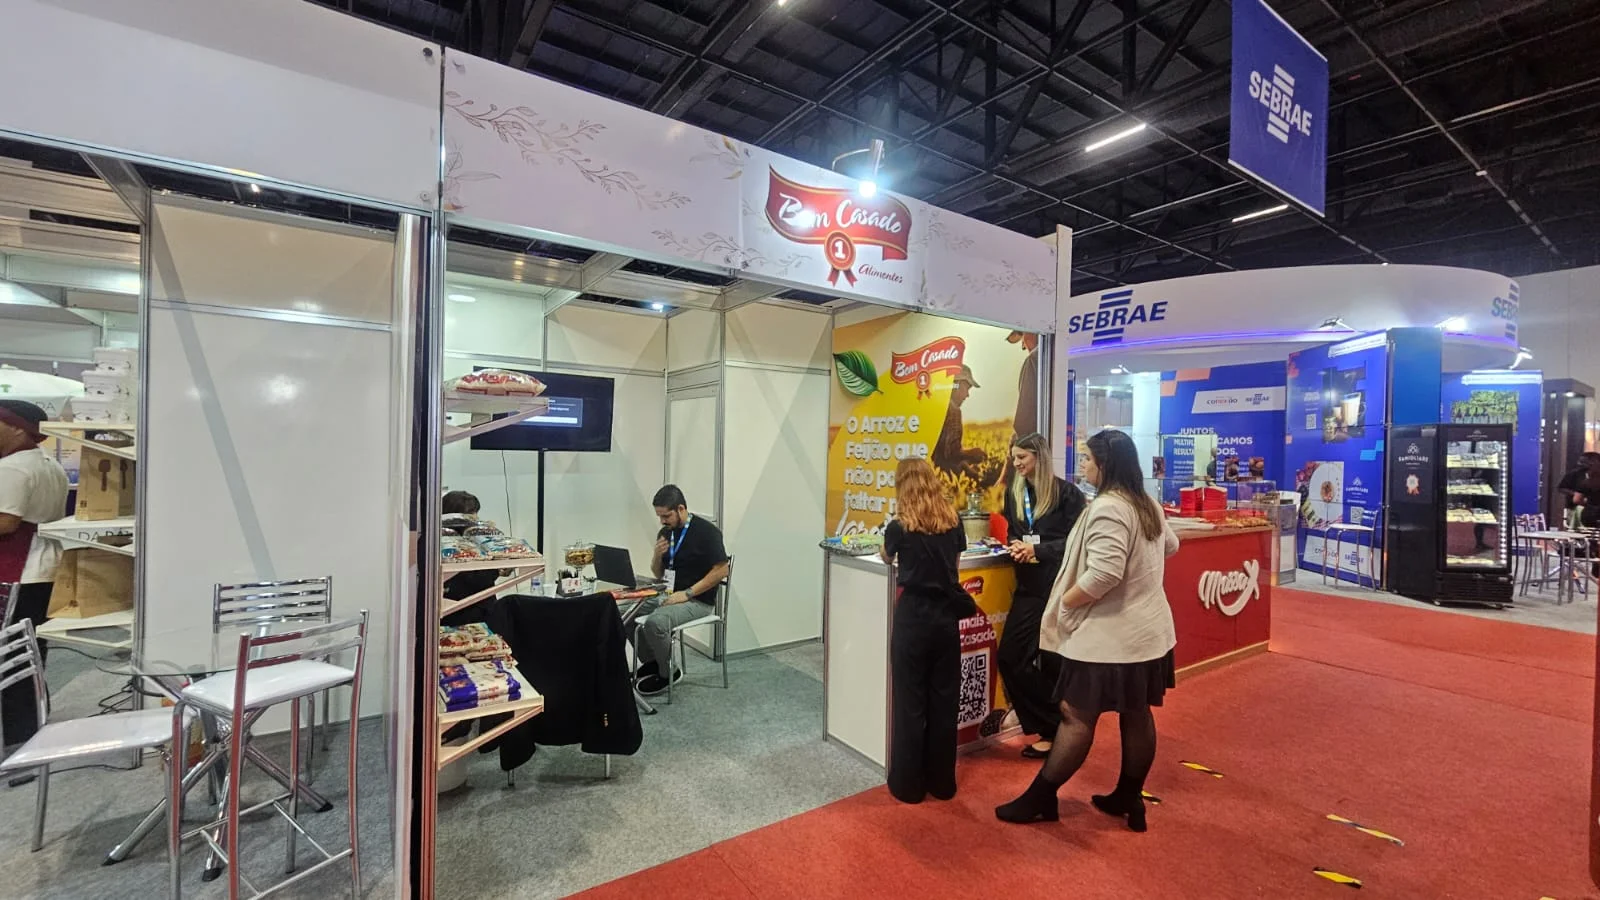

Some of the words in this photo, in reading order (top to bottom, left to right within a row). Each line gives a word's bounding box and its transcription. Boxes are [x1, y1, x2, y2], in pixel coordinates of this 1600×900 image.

[1248, 70, 1313, 137] SEBRAE
[778, 192, 831, 229] Bm
[835, 199, 901, 234] Casado
[834, 240, 846, 259] 1
[1068, 301, 1169, 334] SEBRAE
[895, 361, 918, 377] Bem
[921, 344, 959, 368] Casado
[920, 375, 926, 386] 1
[861, 415, 905, 434] Arroz
[908, 414, 919, 433] e
[846, 438, 892, 464] Feijão
[844, 465, 873, 486] não
[844, 489, 886, 513] faltar
[959, 613, 985, 629] mais
